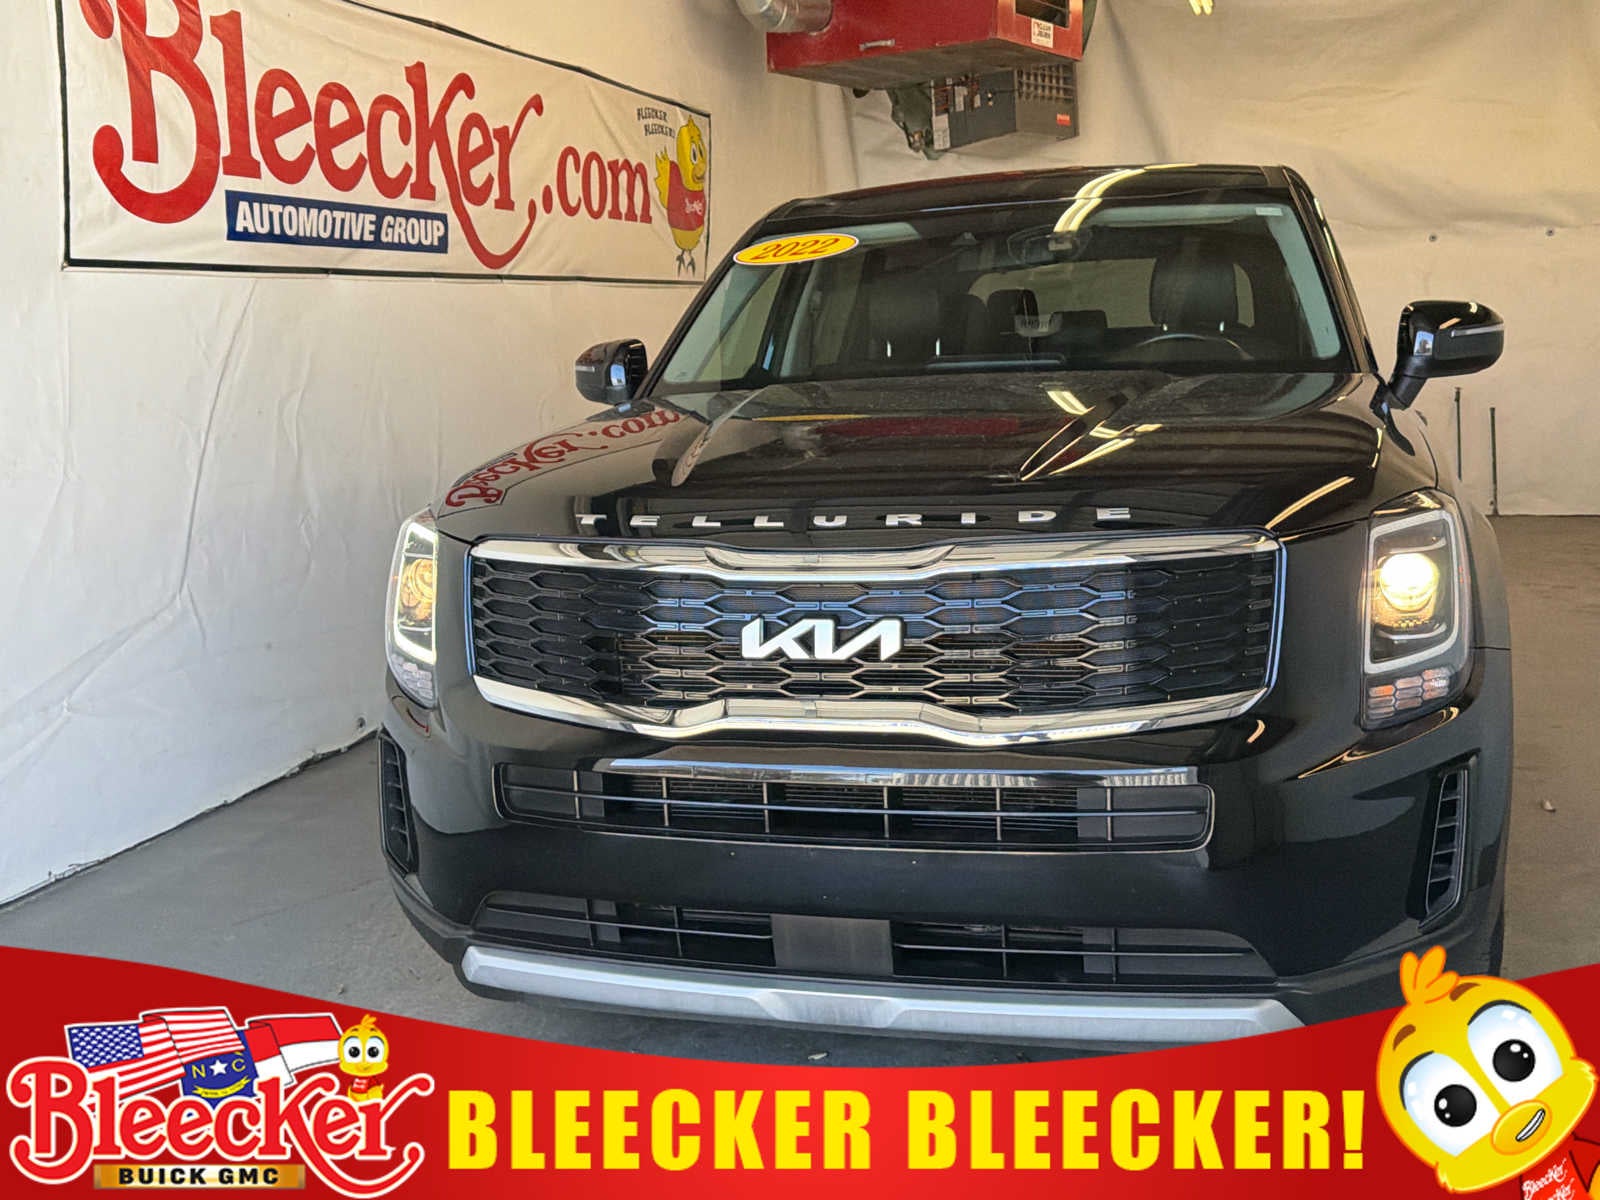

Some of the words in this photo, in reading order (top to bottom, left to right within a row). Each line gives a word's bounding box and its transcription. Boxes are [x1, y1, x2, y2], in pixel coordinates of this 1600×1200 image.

[235, 200, 377, 242] AUTOMOTIVE
[380, 215, 445, 246] GROUP
[750, 237, 841, 261] 2022
[575, 506, 1131, 527] TELLURIDE
